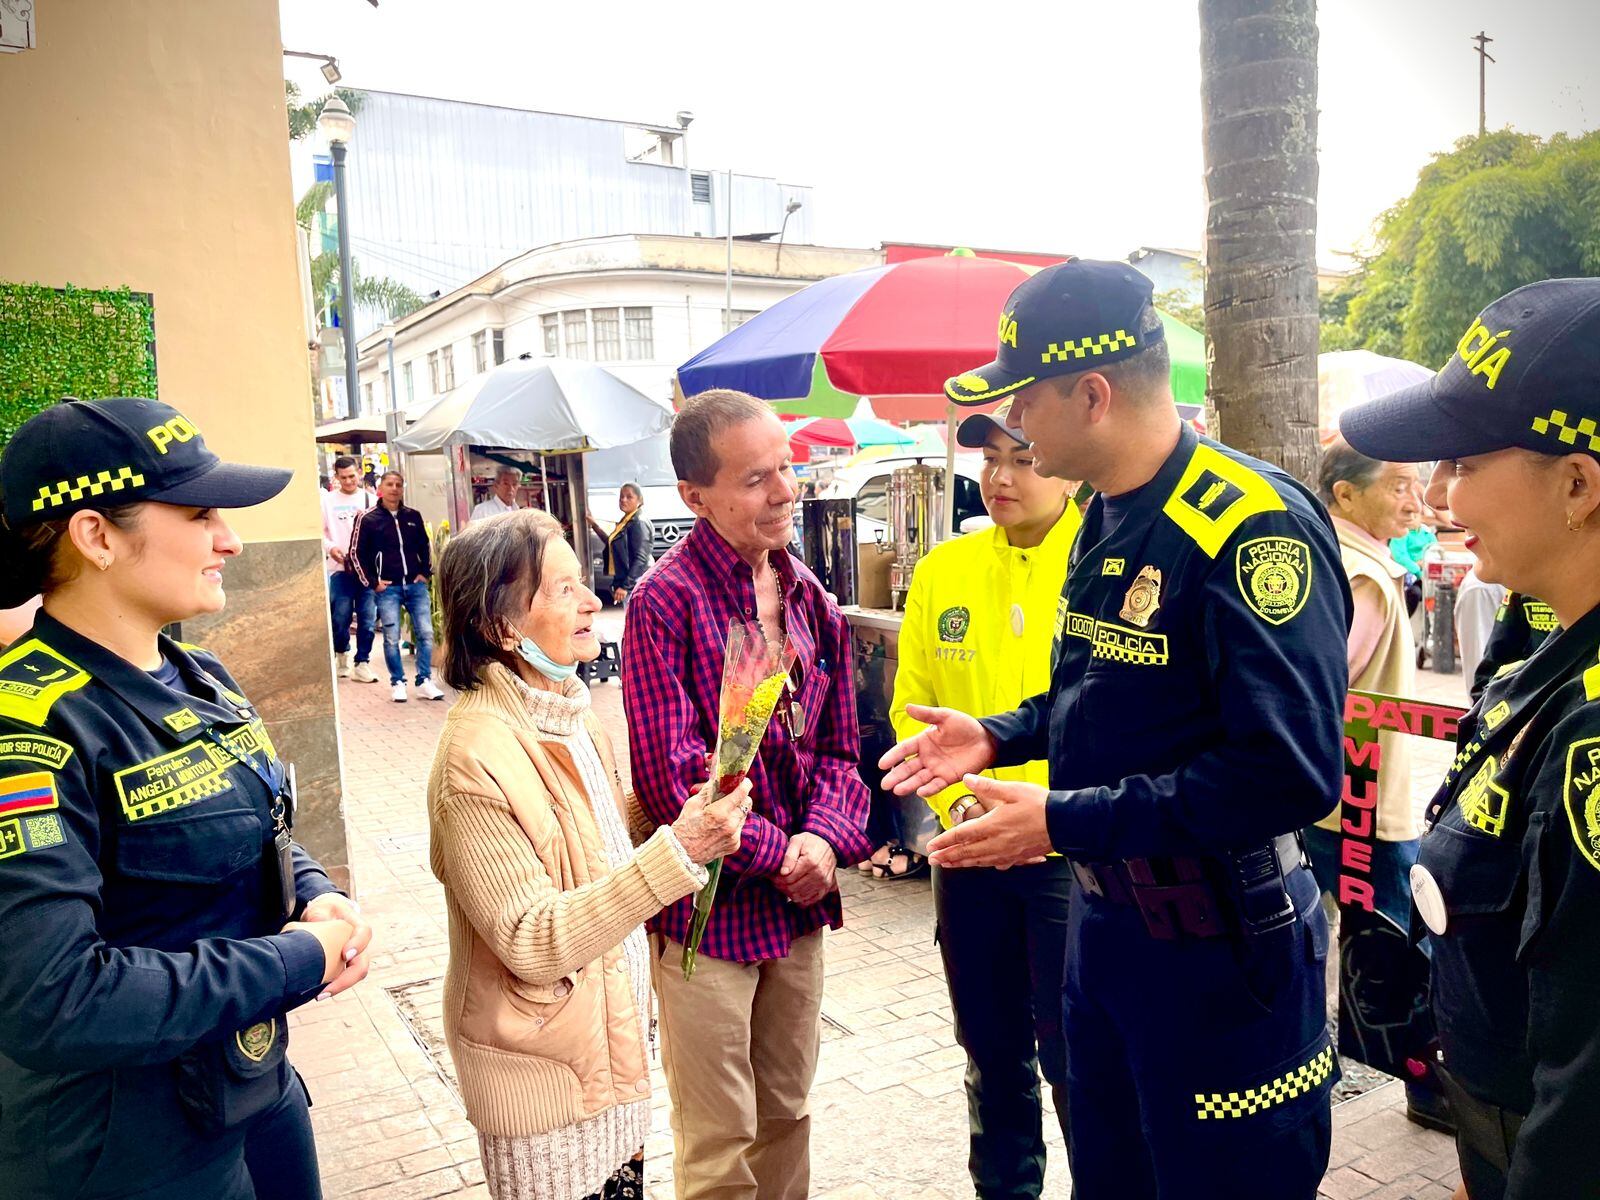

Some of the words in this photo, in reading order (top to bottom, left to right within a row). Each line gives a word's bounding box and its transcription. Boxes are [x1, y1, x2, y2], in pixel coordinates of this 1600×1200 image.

[1248, 541, 1300, 558] POLICÍA
[1241, 552, 1305, 574] NACIONAL
[1098, 630, 1158, 654] POLICÍA
[15, 742, 31, 753] SER
[32, 743, 62, 761] POLICÍA
[129, 776, 177, 804] ANGELA
[1339, 737, 1381, 912] MUJER
